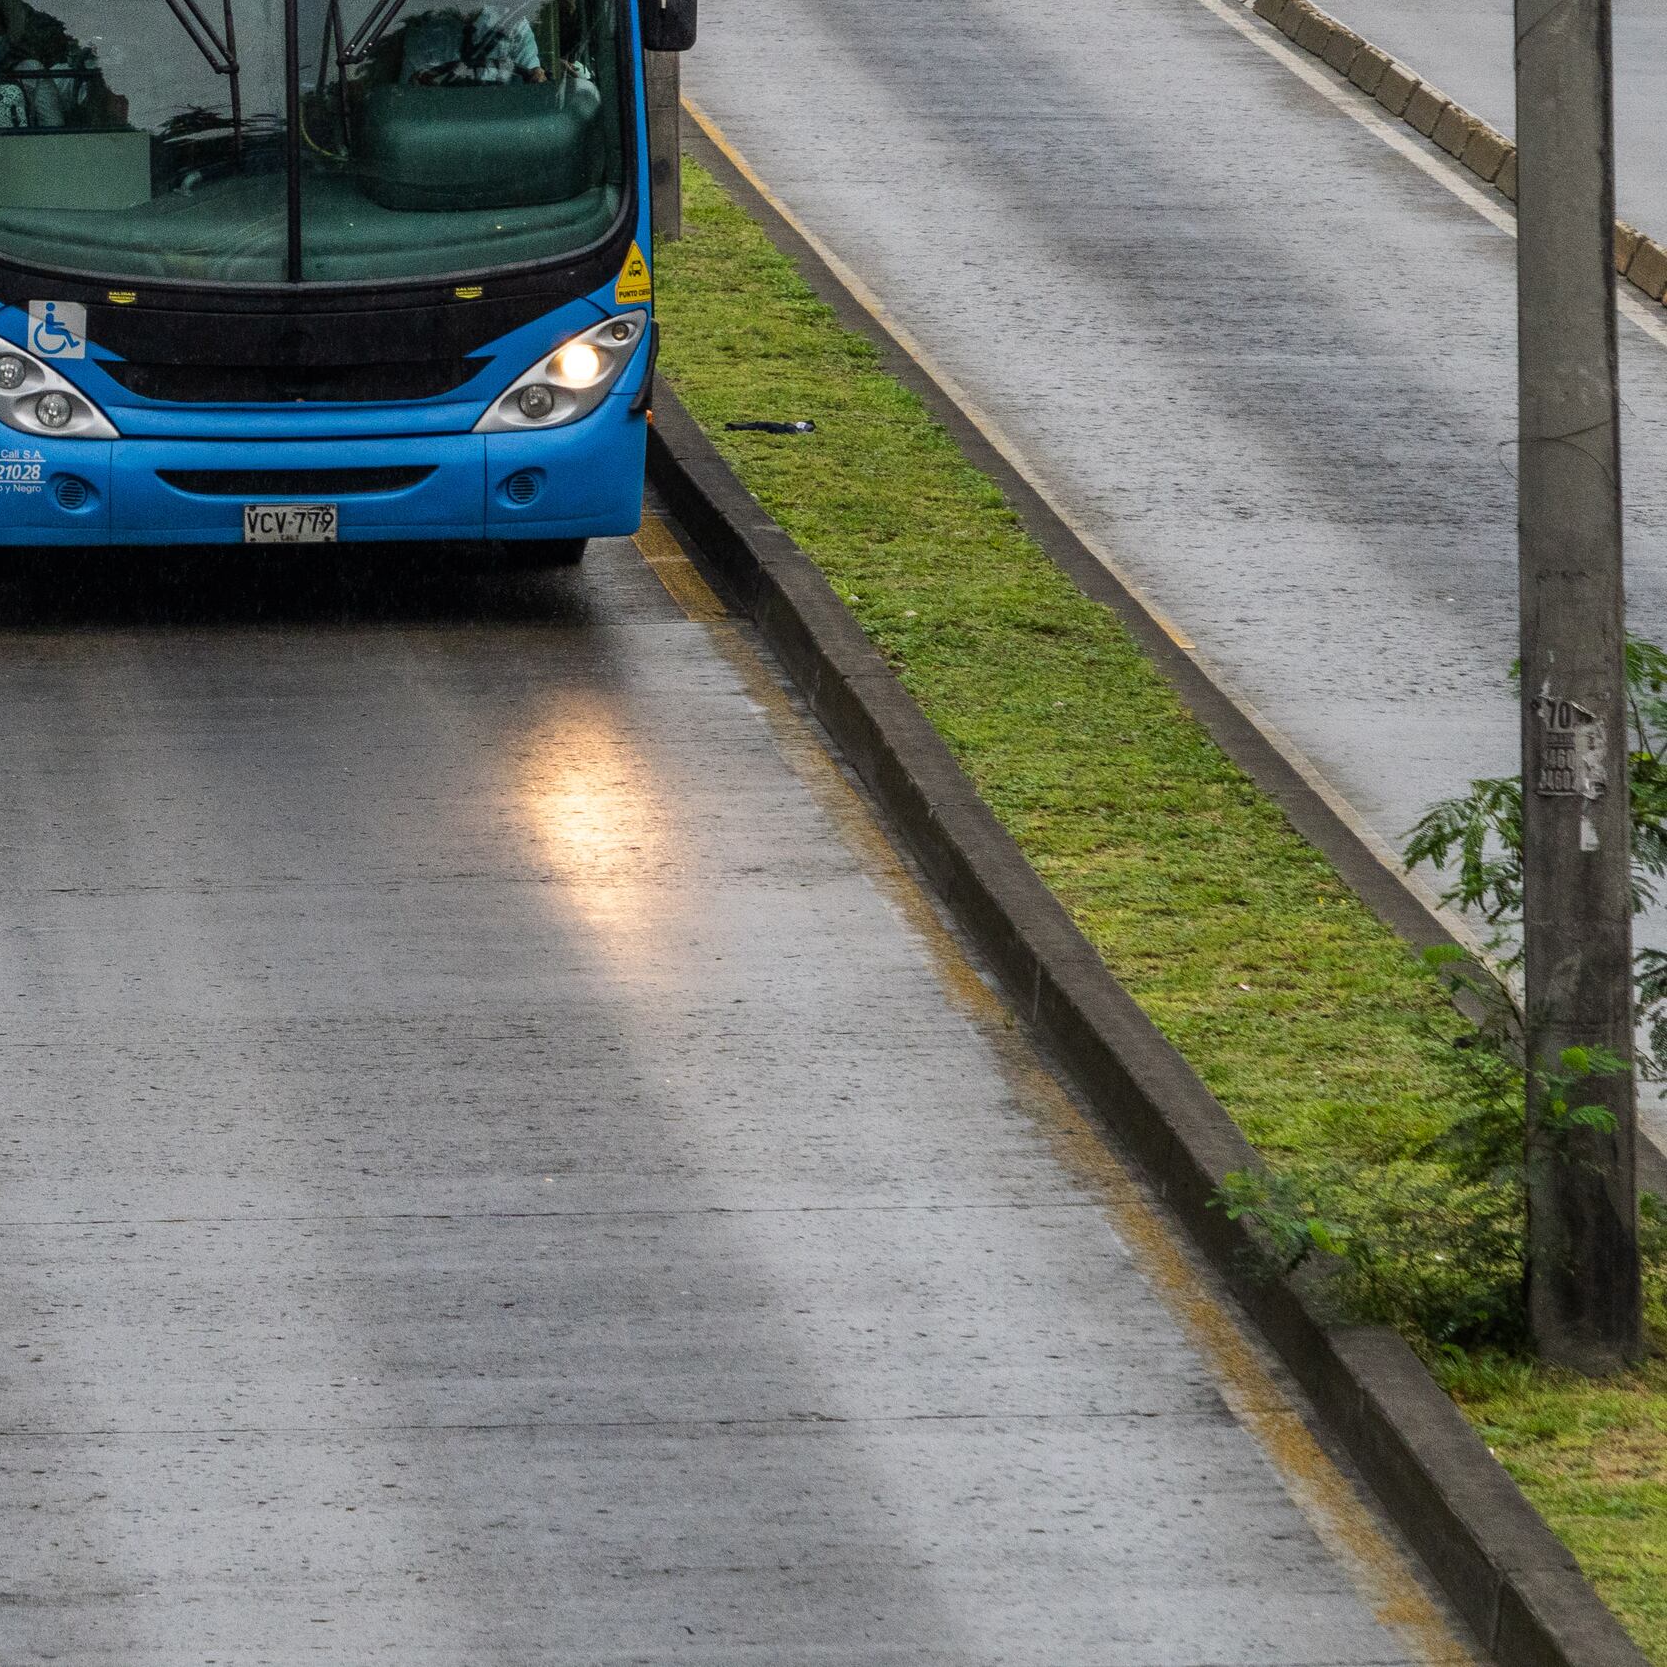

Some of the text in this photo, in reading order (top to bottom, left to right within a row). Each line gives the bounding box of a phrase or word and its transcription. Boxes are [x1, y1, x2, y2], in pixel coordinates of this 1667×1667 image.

[0, 448, 19, 459] Cali
[5, 485, 11, 494] y
[13, 483, 42, 494] Negro
[247, 511, 334, 533] VCV 779
